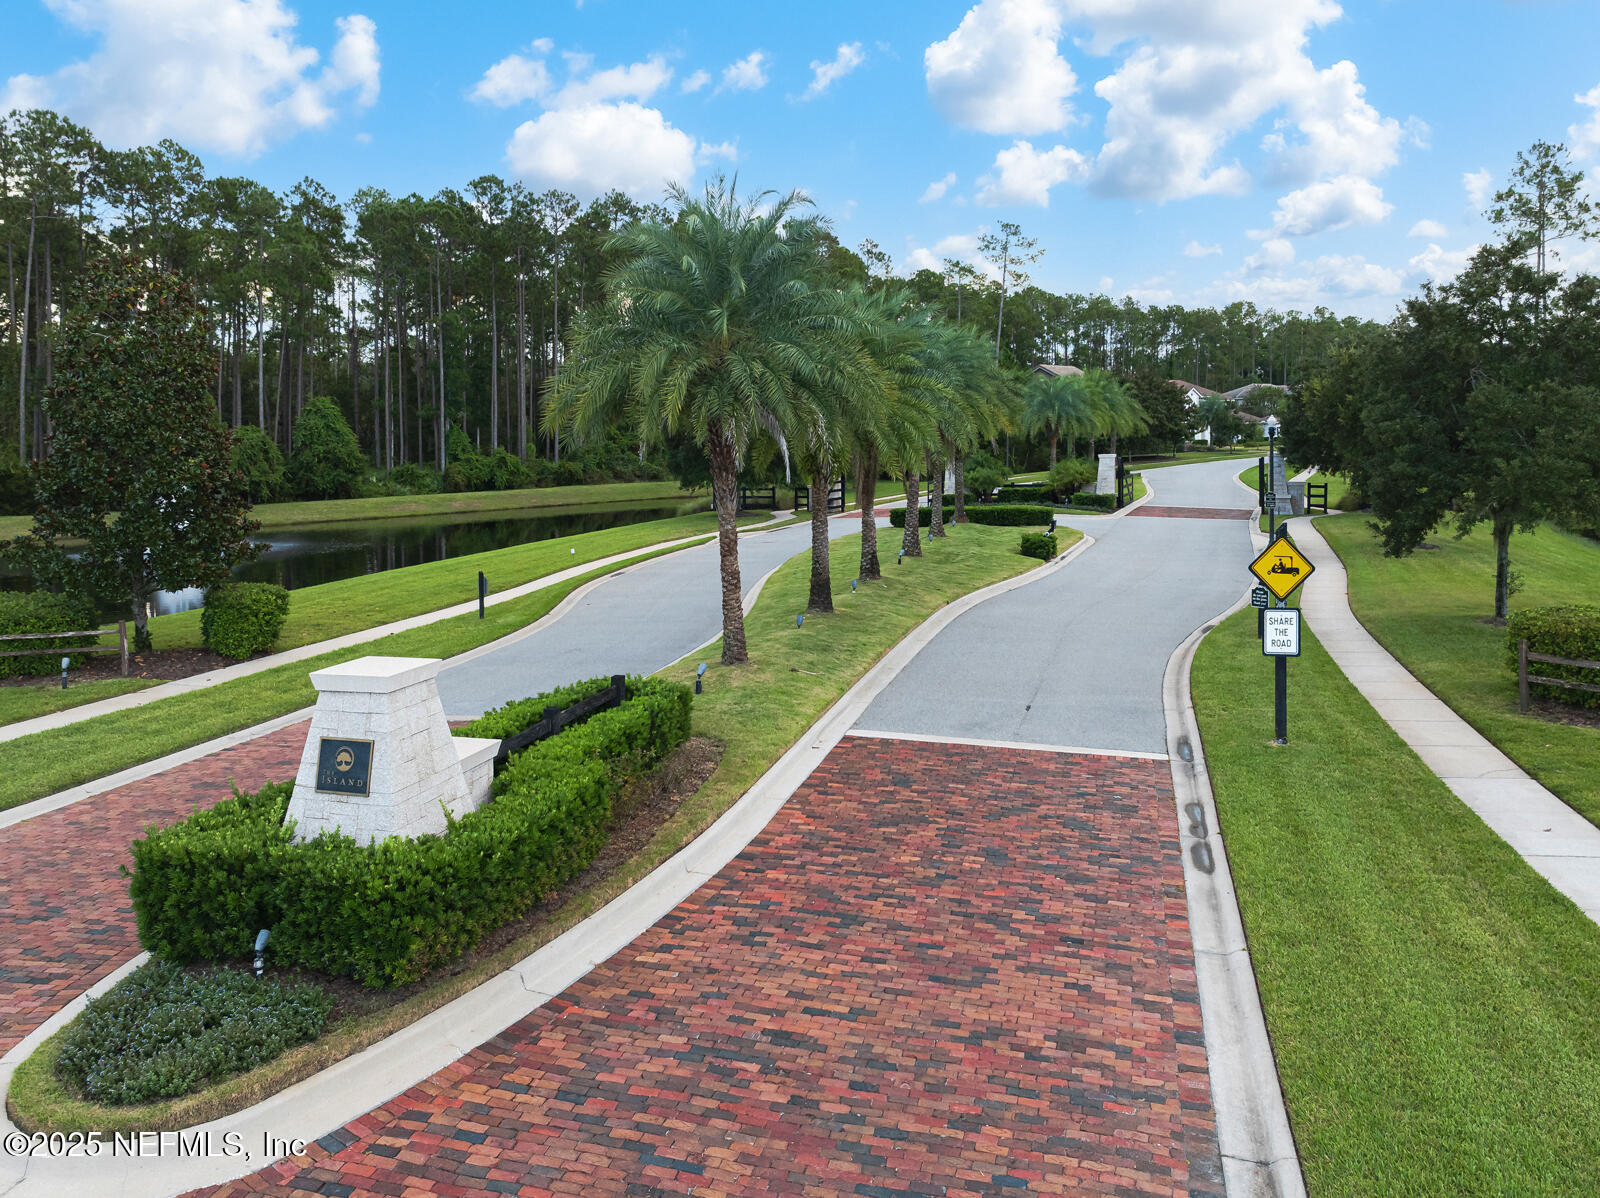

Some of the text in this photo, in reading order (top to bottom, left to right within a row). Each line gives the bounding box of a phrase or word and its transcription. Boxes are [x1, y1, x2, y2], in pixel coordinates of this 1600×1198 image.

[1268, 617, 1294, 626] SHARE
[1274, 628, 1289, 637] THE
[1271, 639, 1292, 648] ROAD
[321, 775, 364, 787] ISLAND
